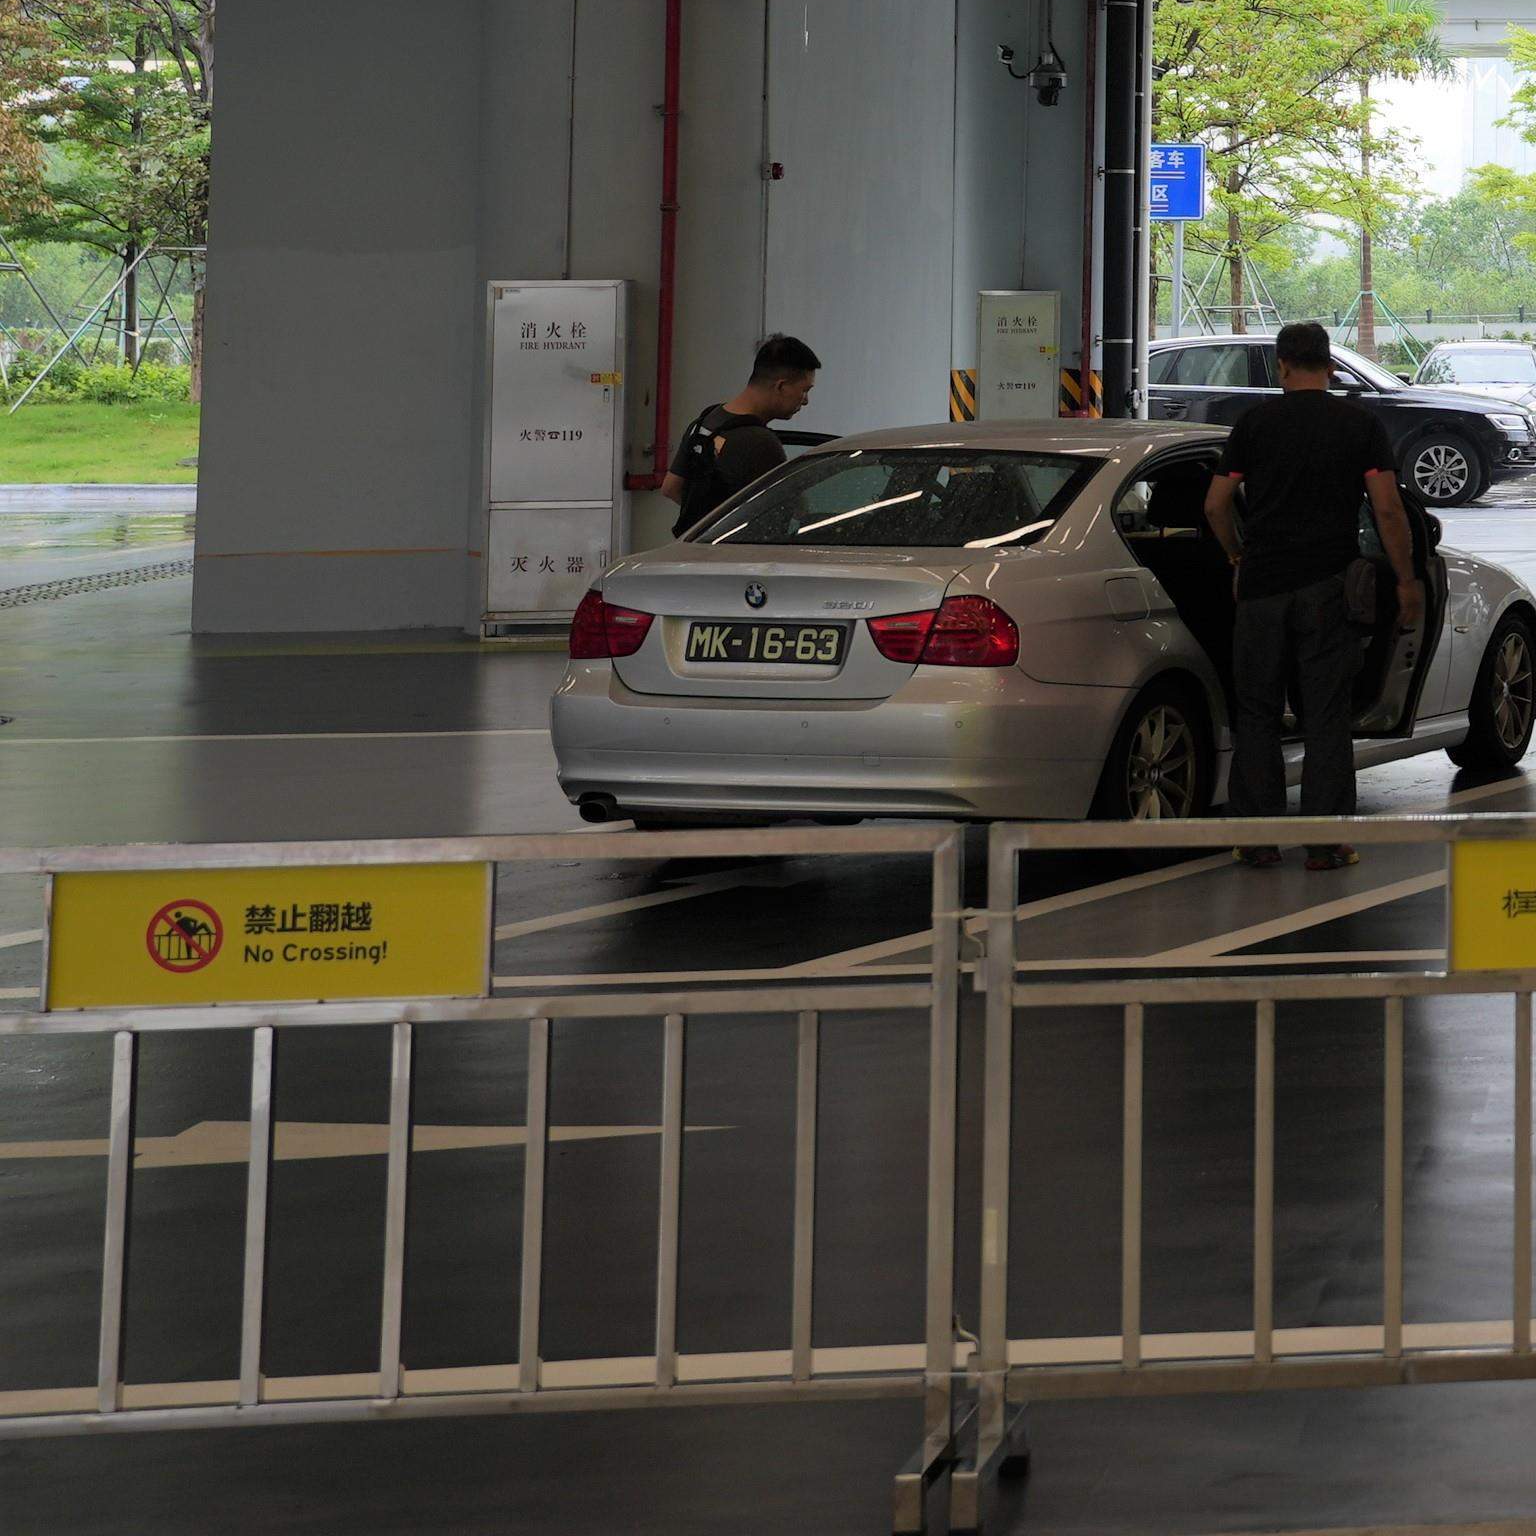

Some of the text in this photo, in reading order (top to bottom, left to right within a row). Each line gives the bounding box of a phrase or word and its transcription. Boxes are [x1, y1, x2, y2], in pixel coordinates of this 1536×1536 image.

[521, 321, 587, 339] 消火栓
[520, 341, 586, 351] FIRE HYDRANT
[511, 555, 585, 574] 灭火器
[689, 626, 840, 661] MK-16-63
[244, 901, 373, 934] 禁止翻越
[244, 940, 388, 965] No Crossing!
